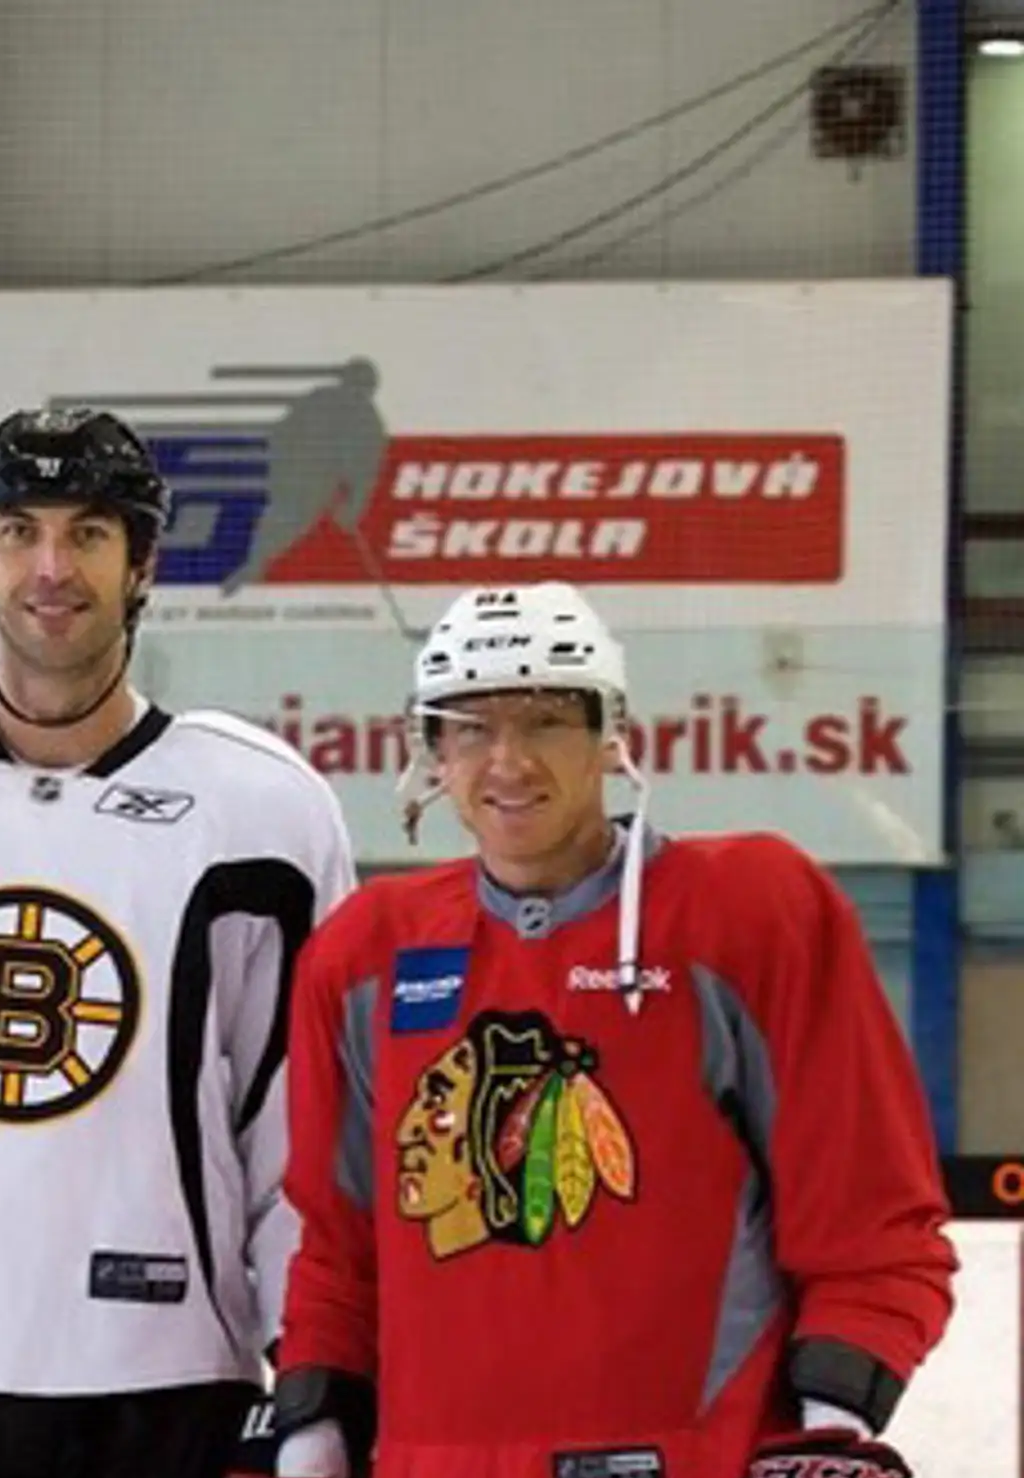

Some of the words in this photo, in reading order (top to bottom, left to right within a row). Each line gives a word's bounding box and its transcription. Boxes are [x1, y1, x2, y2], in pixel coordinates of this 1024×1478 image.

[390, 453, 820, 499] HOKEJOVÁ
[386, 513, 649, 560] ŠKOLA
[264, 694, 410, 775] ian
[566, 965, 672, 992] Reeok
